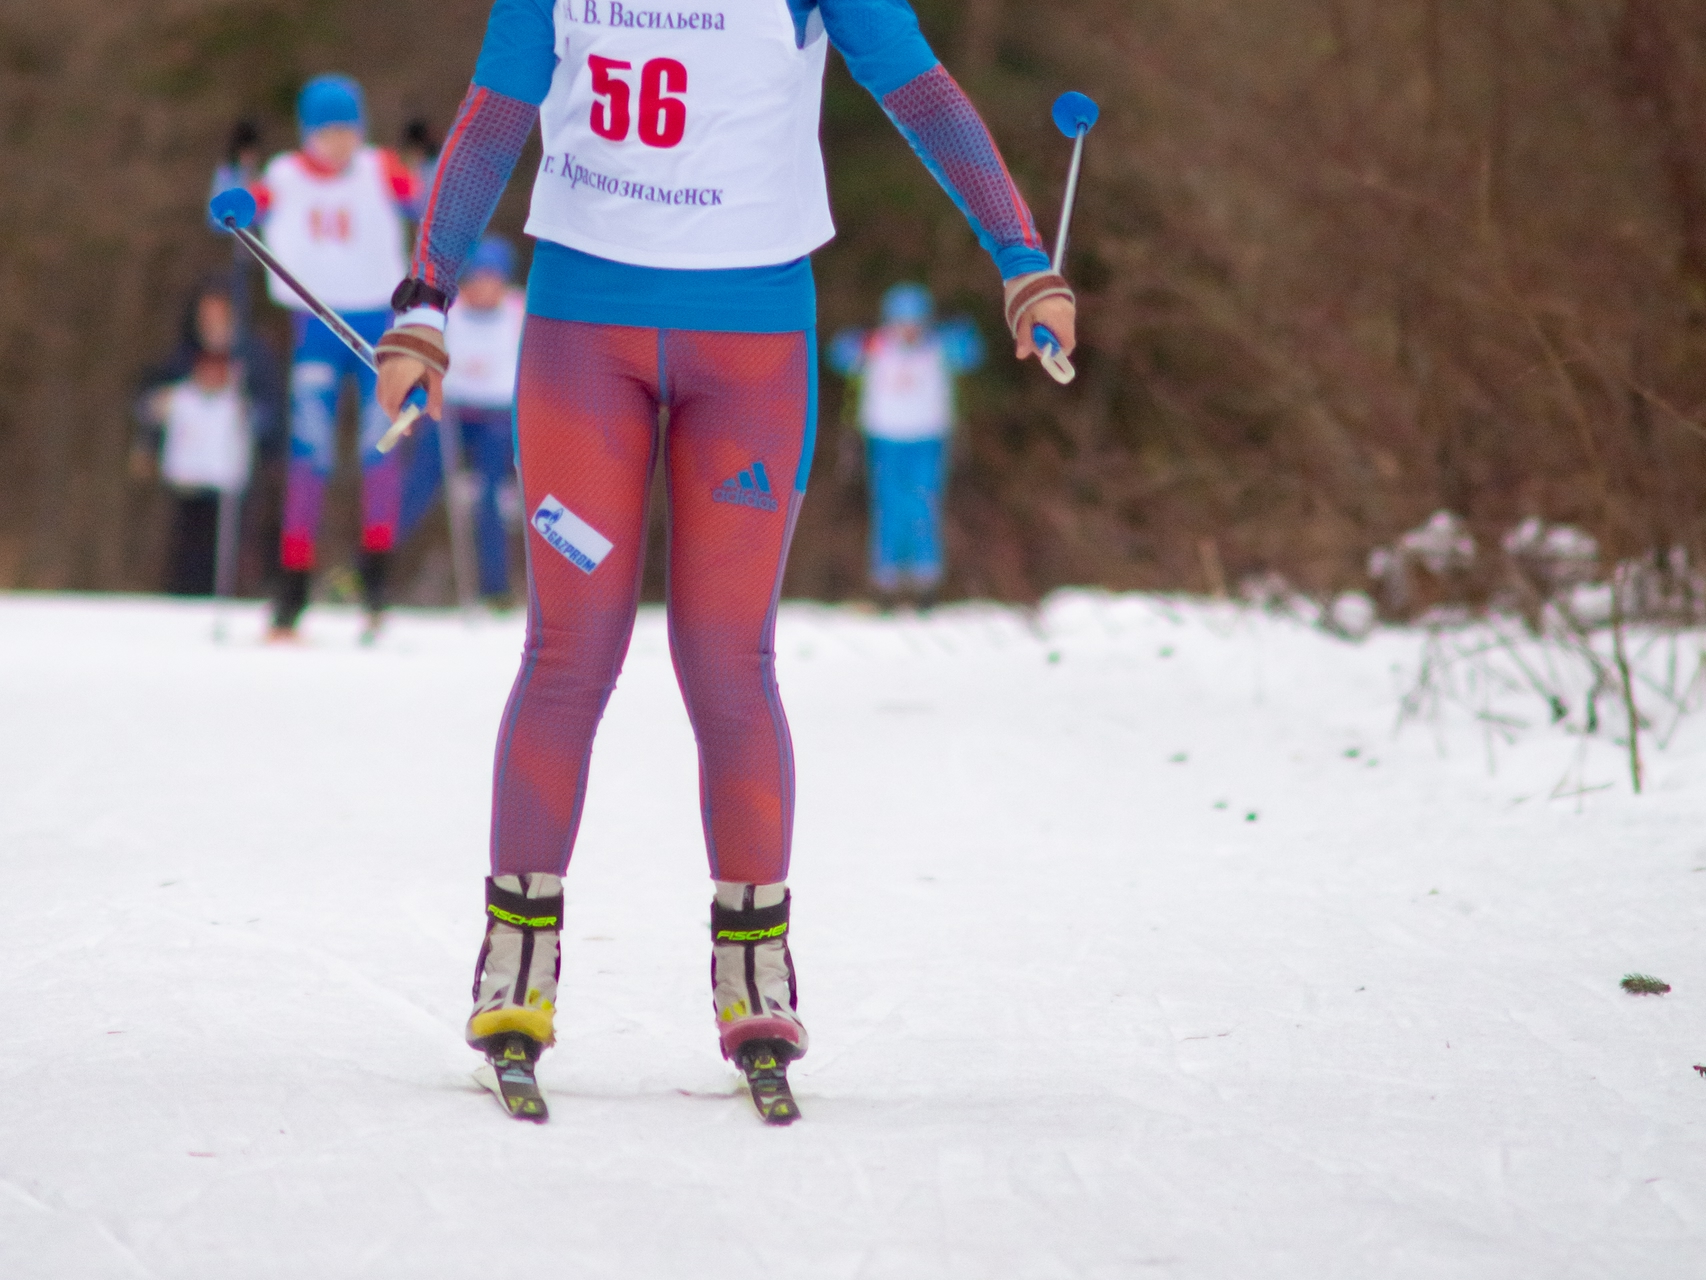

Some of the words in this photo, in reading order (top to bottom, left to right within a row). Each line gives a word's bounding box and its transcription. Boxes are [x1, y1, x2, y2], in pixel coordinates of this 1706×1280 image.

[609, 0, 725, 30] Васильева
[587, 52, 688, 149] 56
[543, 154, 555, 174] г.
[560, 152, 724, 206] Краснознаменск
[711, 486, 779, 512] adidas
[546, 529, 597, 572] GAZPROM
[487, 904, 558, 927] FISCHER
